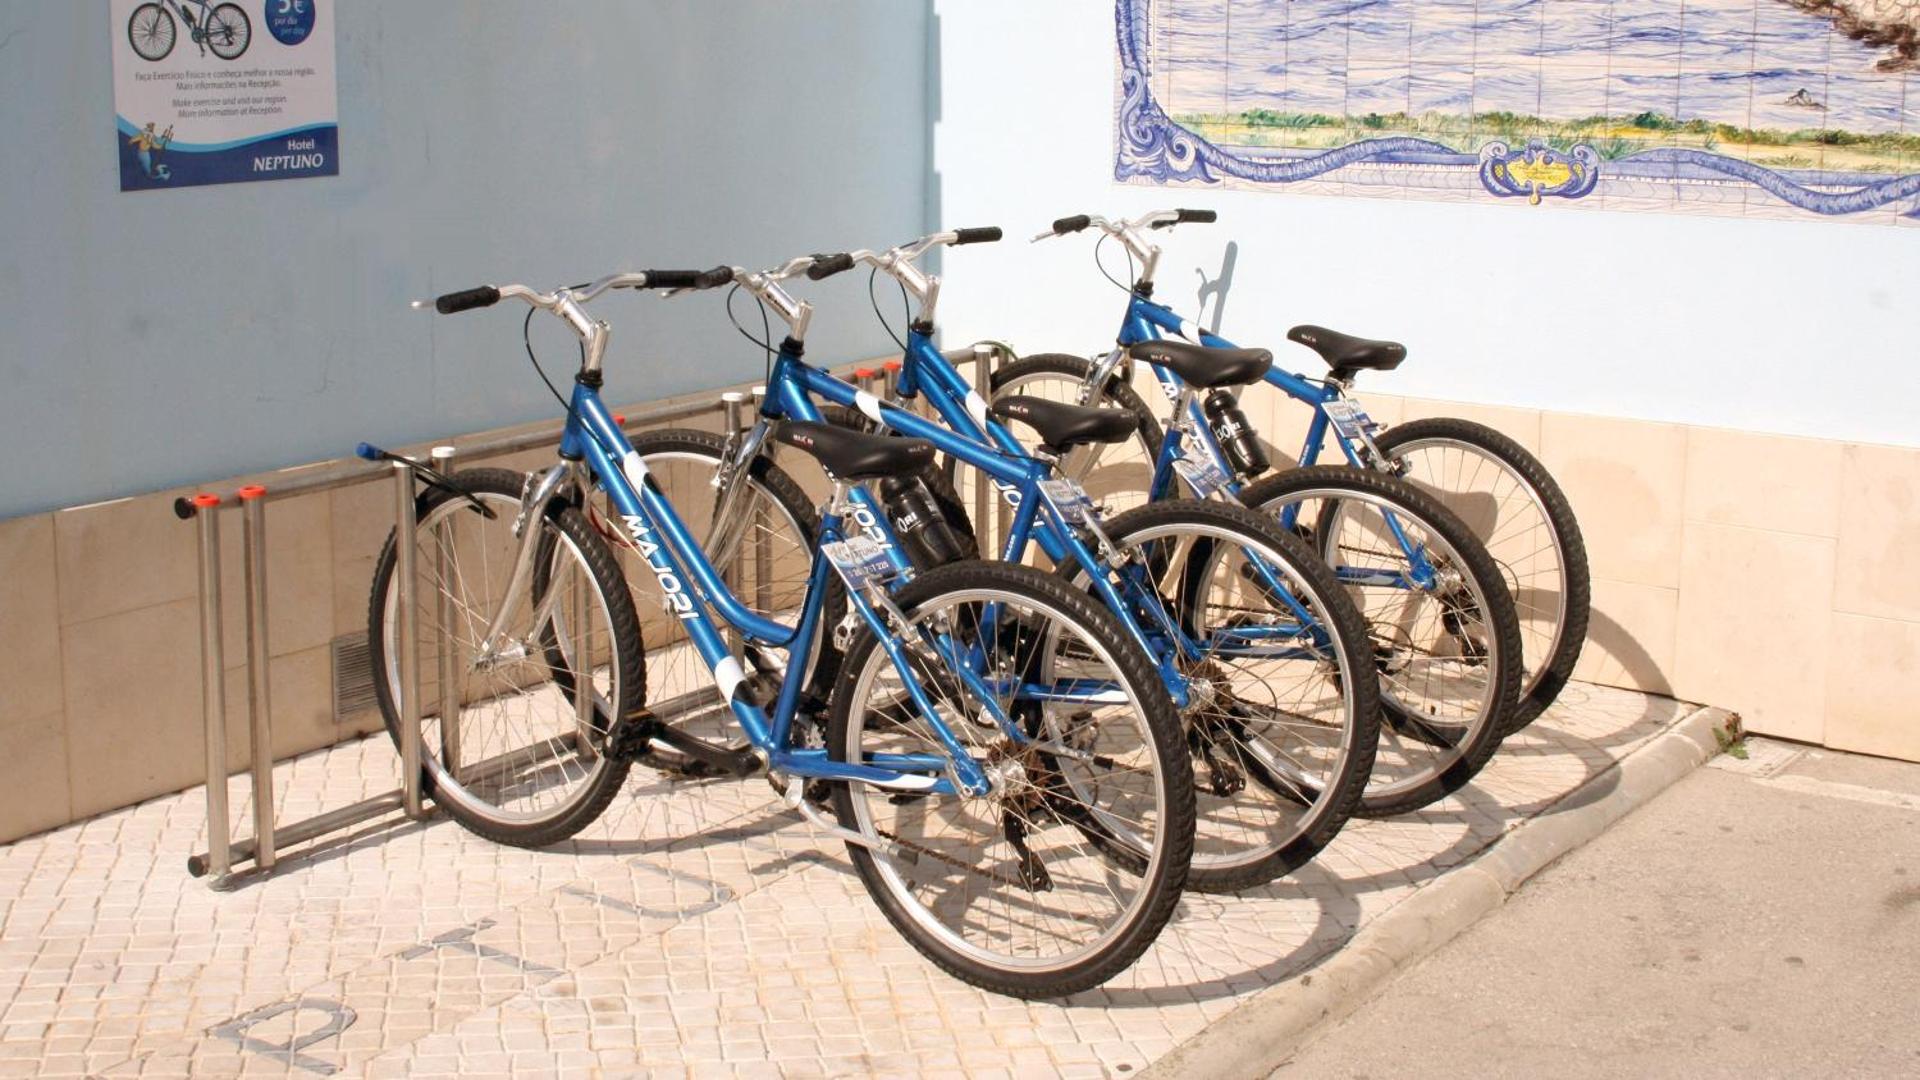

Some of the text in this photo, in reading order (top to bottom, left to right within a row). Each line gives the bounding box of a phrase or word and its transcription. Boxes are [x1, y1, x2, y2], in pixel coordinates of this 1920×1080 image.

[288, 138, 315, 150] Hotel
[253, 153, 324, 171] NEPTUNO
[620, 514, 699, 618] MAJORI
